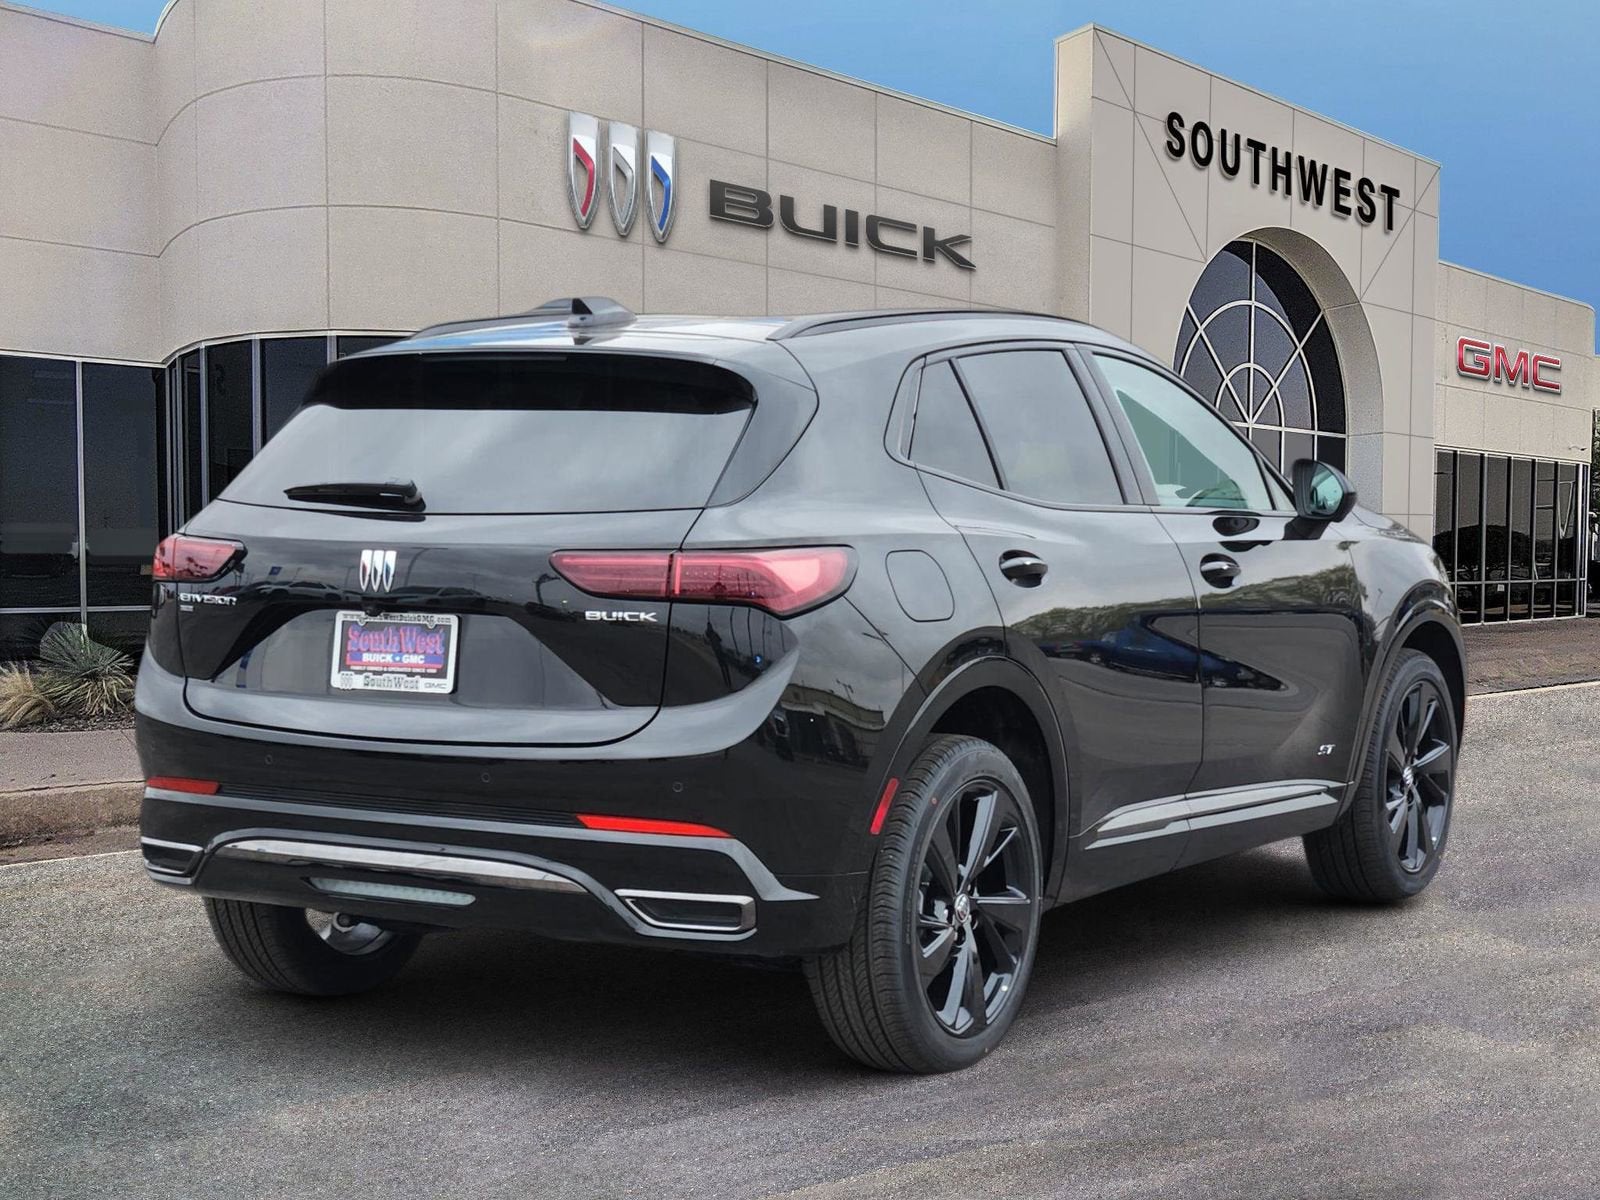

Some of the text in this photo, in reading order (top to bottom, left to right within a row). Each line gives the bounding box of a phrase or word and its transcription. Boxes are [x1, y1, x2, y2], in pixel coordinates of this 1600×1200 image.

[1166, 112, 1400, 231] SOUTHWEST
[709, 179, 976, 270] BUICK
[1457, 336, 1561, 394] GMC
[585, 610, 657, 622] BUICK
[362, 652, 425, 664] BUICK GMC
